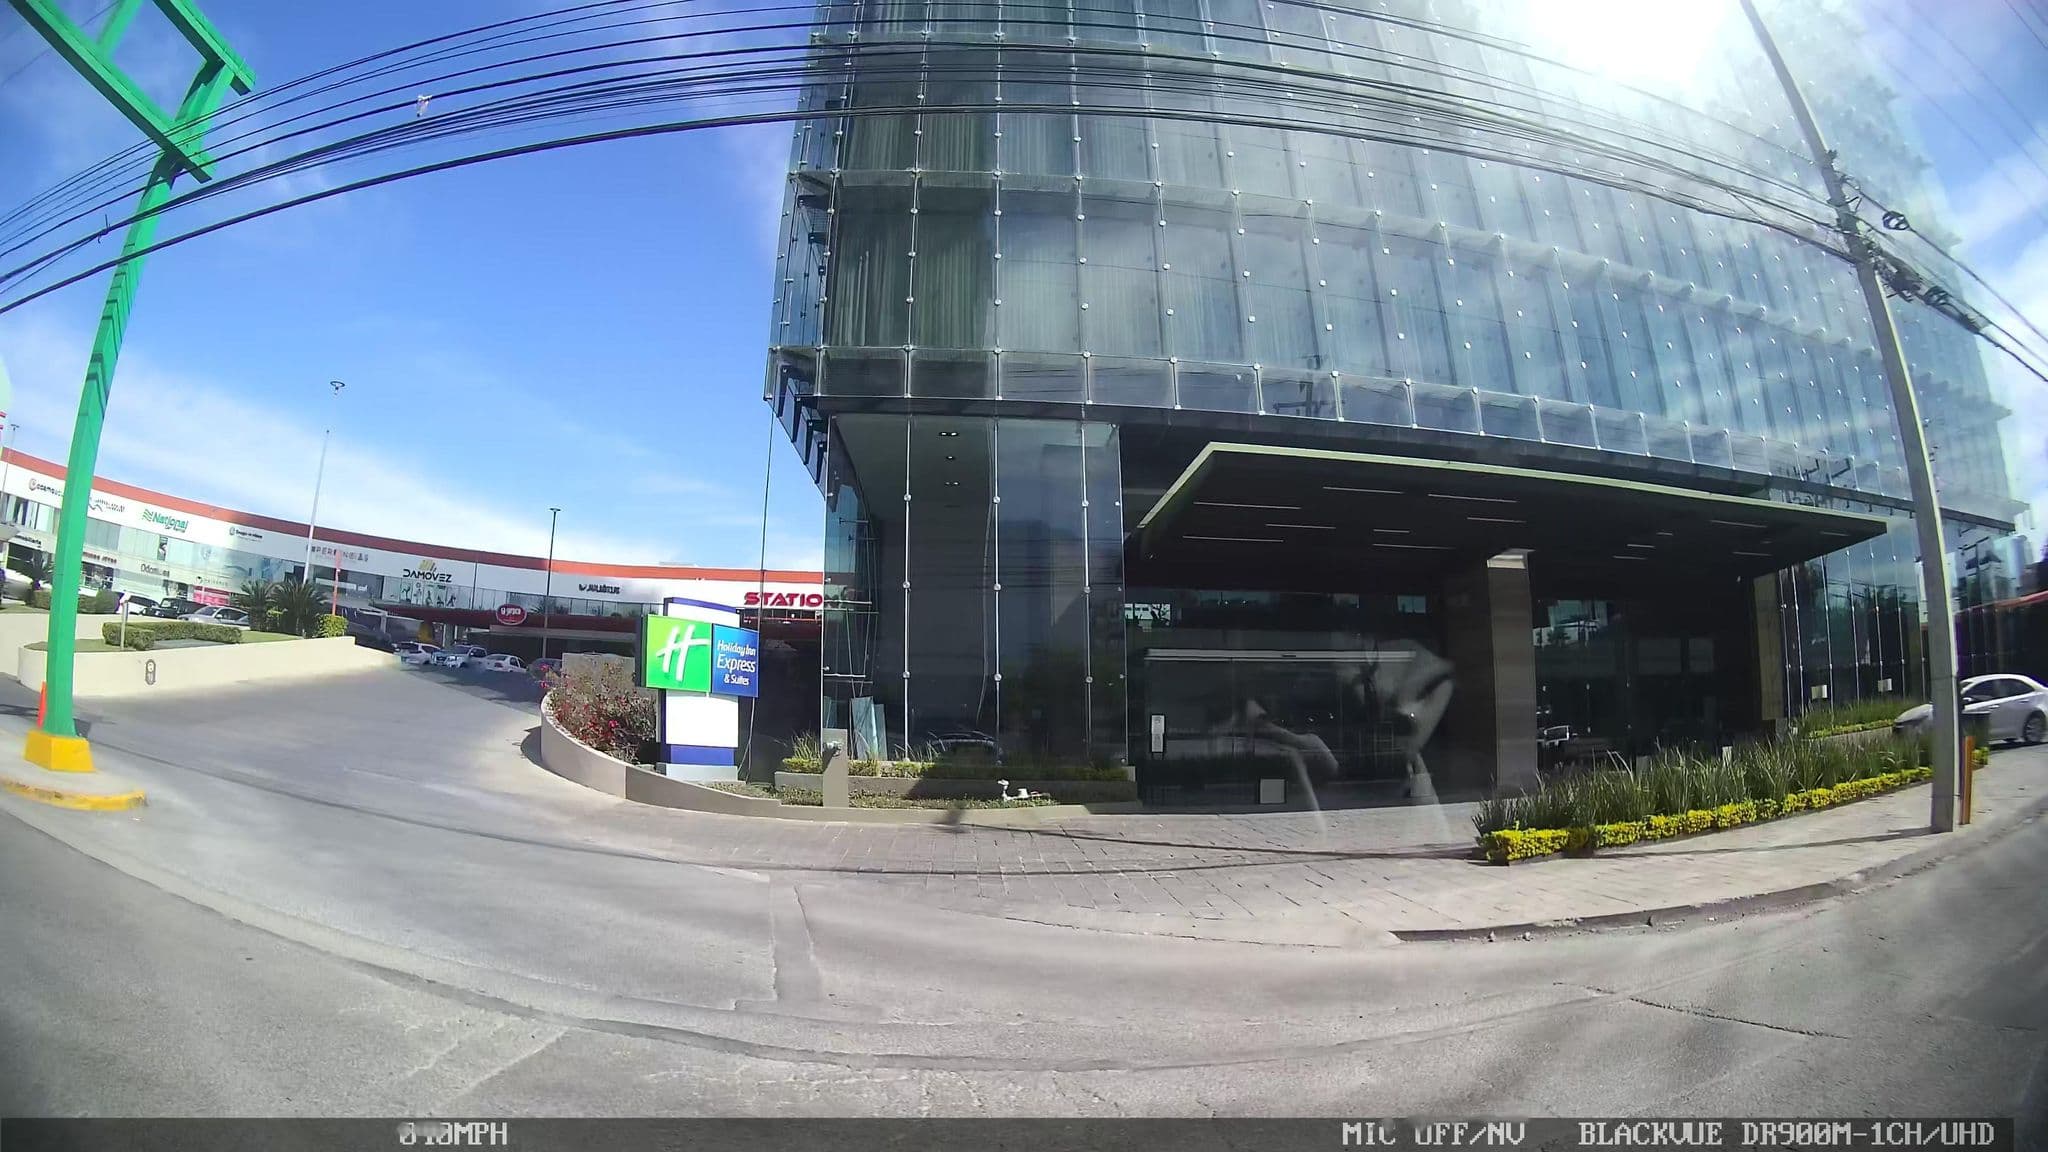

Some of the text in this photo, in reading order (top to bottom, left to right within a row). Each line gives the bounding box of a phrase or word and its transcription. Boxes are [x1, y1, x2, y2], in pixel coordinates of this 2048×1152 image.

[152, 511, 189, 530] National
[402, 568, 453, 583] DAMOVEZ
[717, 639, 757, 657] Holiday Inn
[717, 653, 757, 674] Express
[723, 673, 750, 686] & Suites
